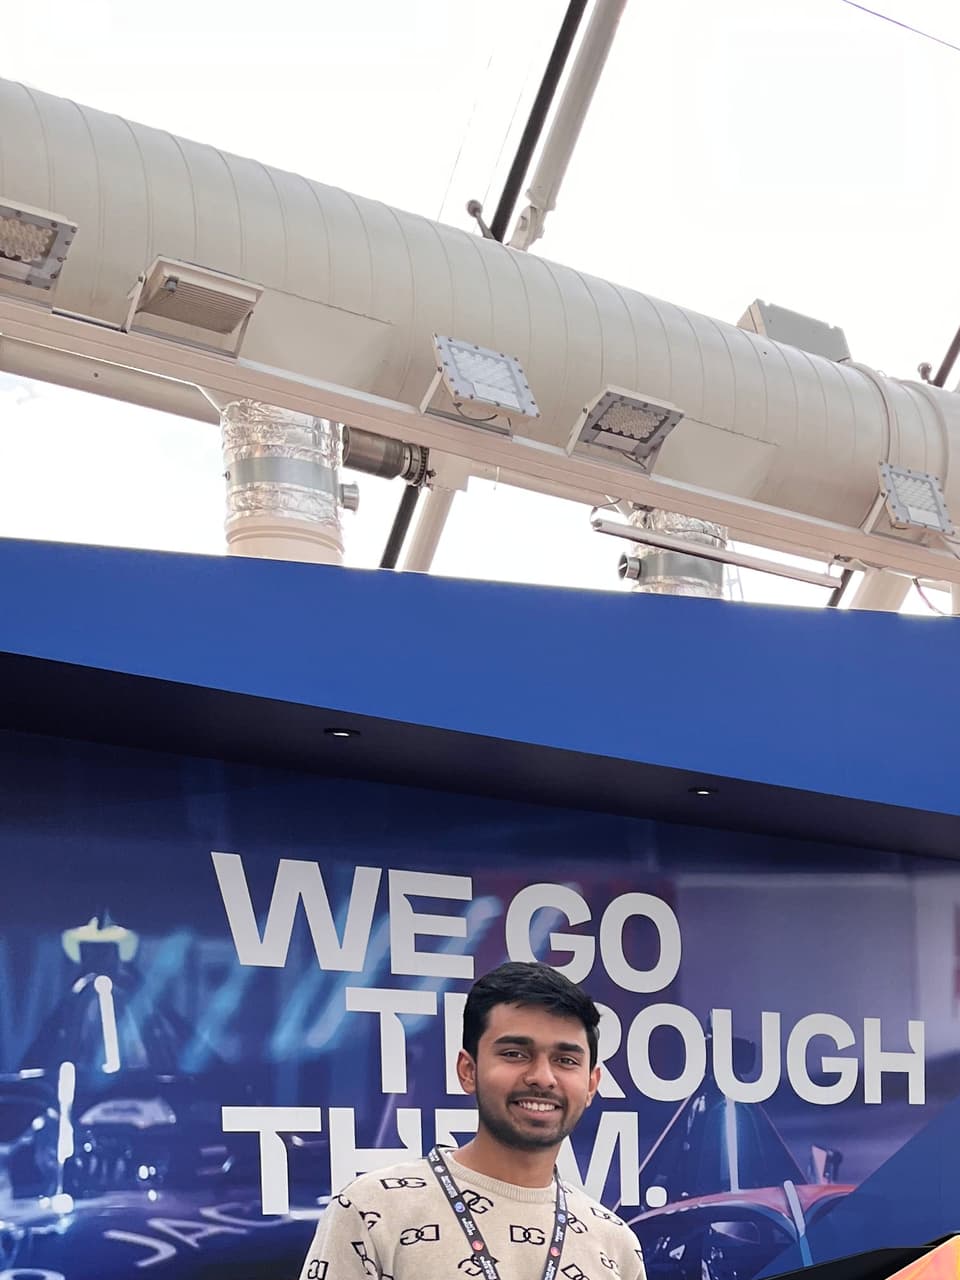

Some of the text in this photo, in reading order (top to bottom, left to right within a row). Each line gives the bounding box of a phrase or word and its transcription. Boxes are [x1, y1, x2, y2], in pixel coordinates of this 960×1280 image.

[211, 851, 682, 994] WE GO
[345, 986, 926, 1105] TOUGH
